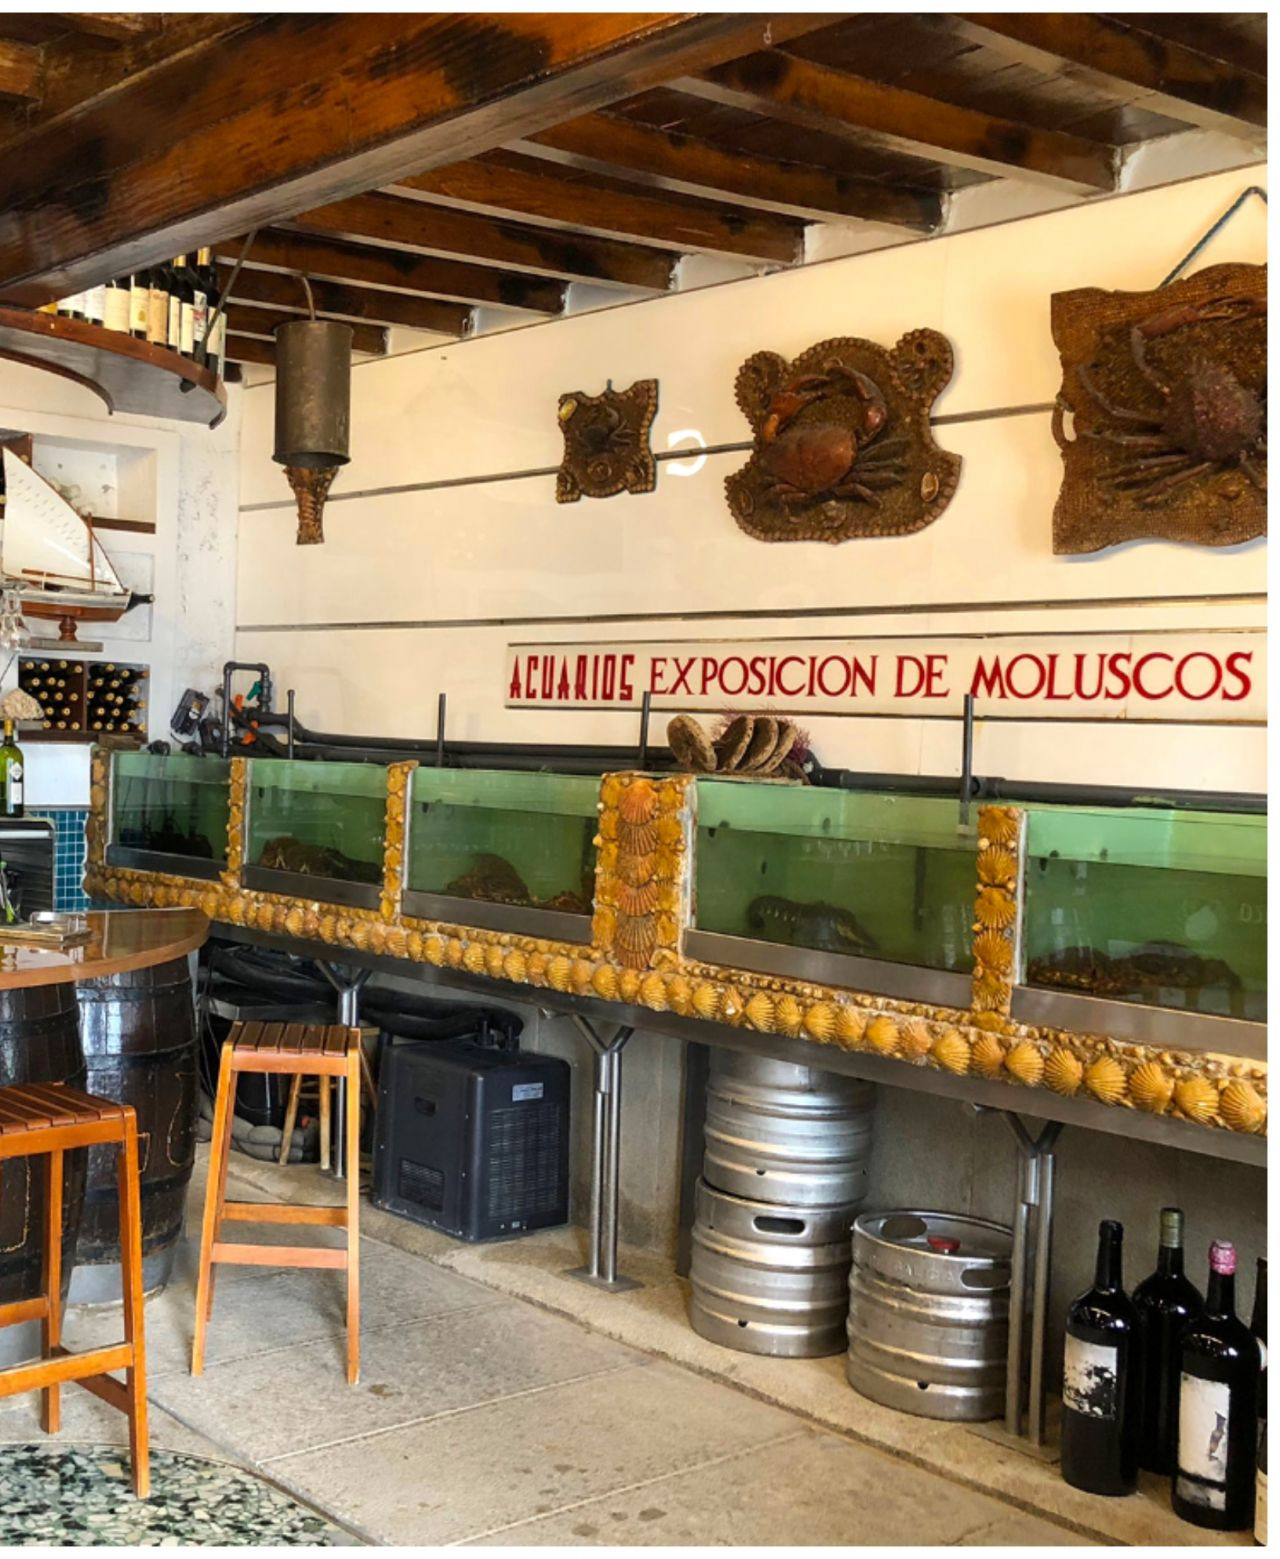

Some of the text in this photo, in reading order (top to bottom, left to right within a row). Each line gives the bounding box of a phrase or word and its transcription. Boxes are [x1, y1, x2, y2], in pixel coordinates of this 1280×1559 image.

[509, 651, 1254, 702] ACUARIOS EXPOSICION DE MOLUSCOS
